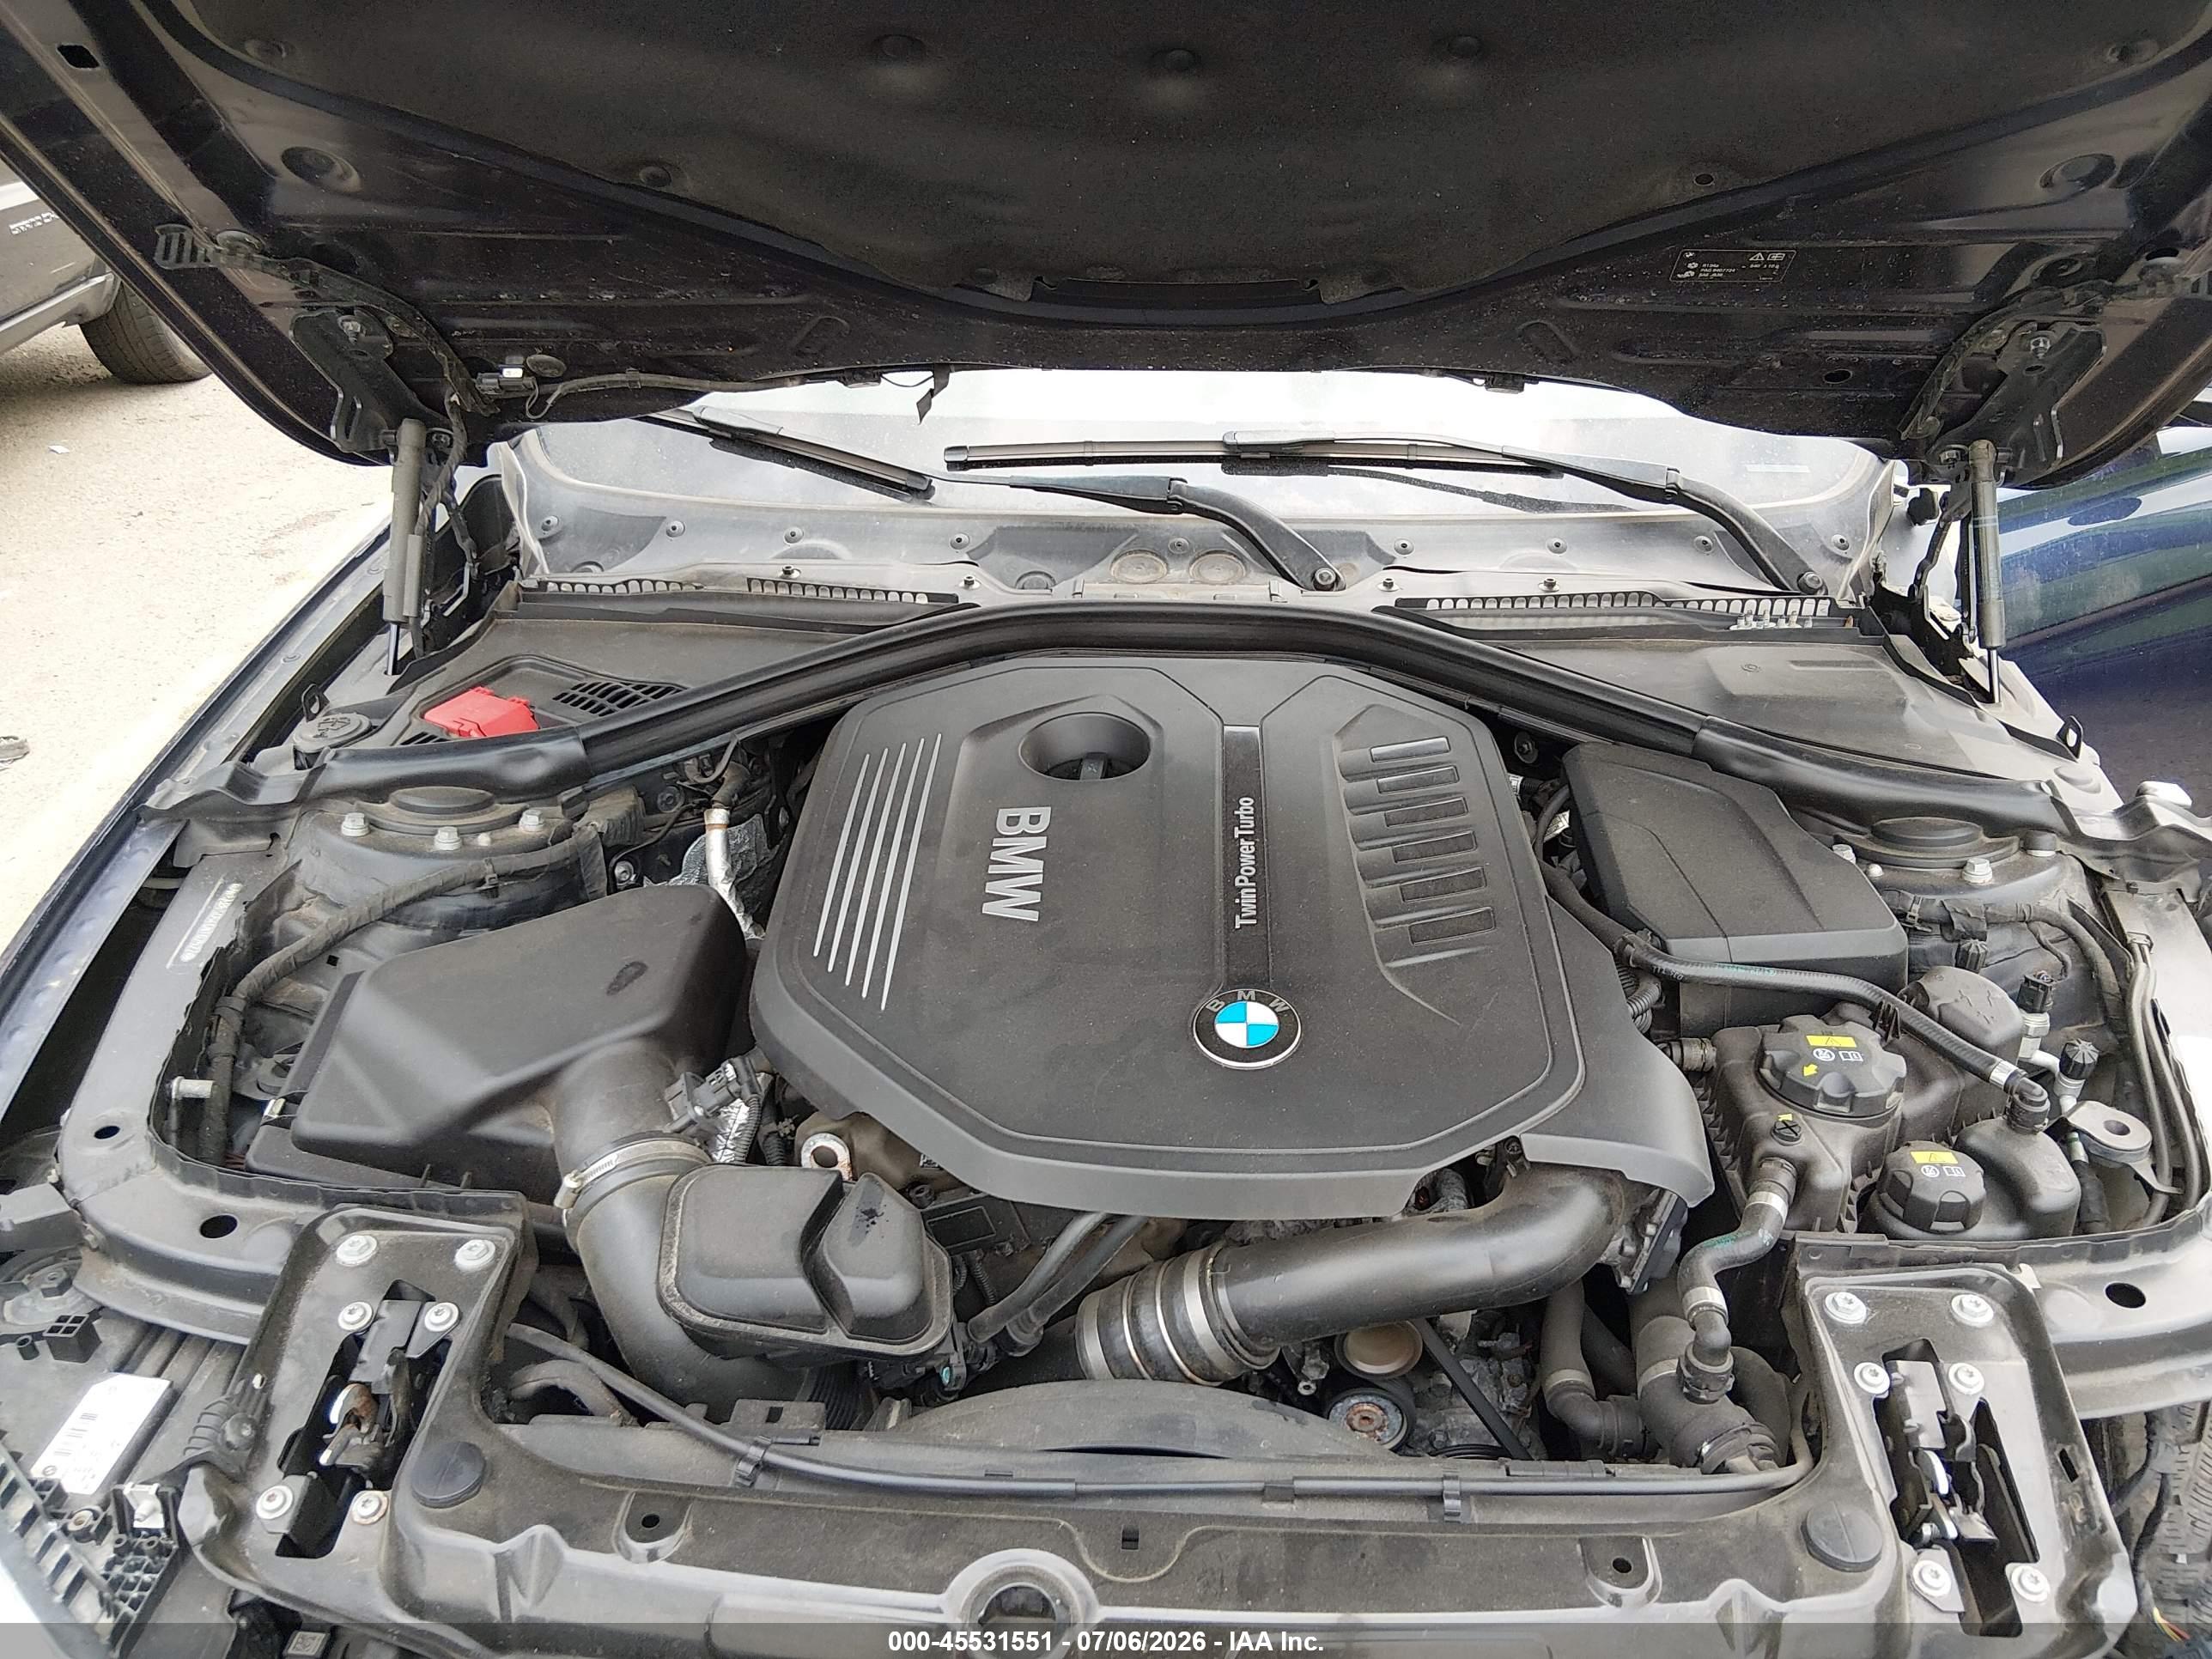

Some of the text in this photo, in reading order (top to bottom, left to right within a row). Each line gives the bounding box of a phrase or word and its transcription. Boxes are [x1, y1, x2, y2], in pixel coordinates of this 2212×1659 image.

[1233, 797, 1255, 838] Turbo
[982, 806, 1052, 922] BMW
[1206, 990, 1290, 1013] BMW
